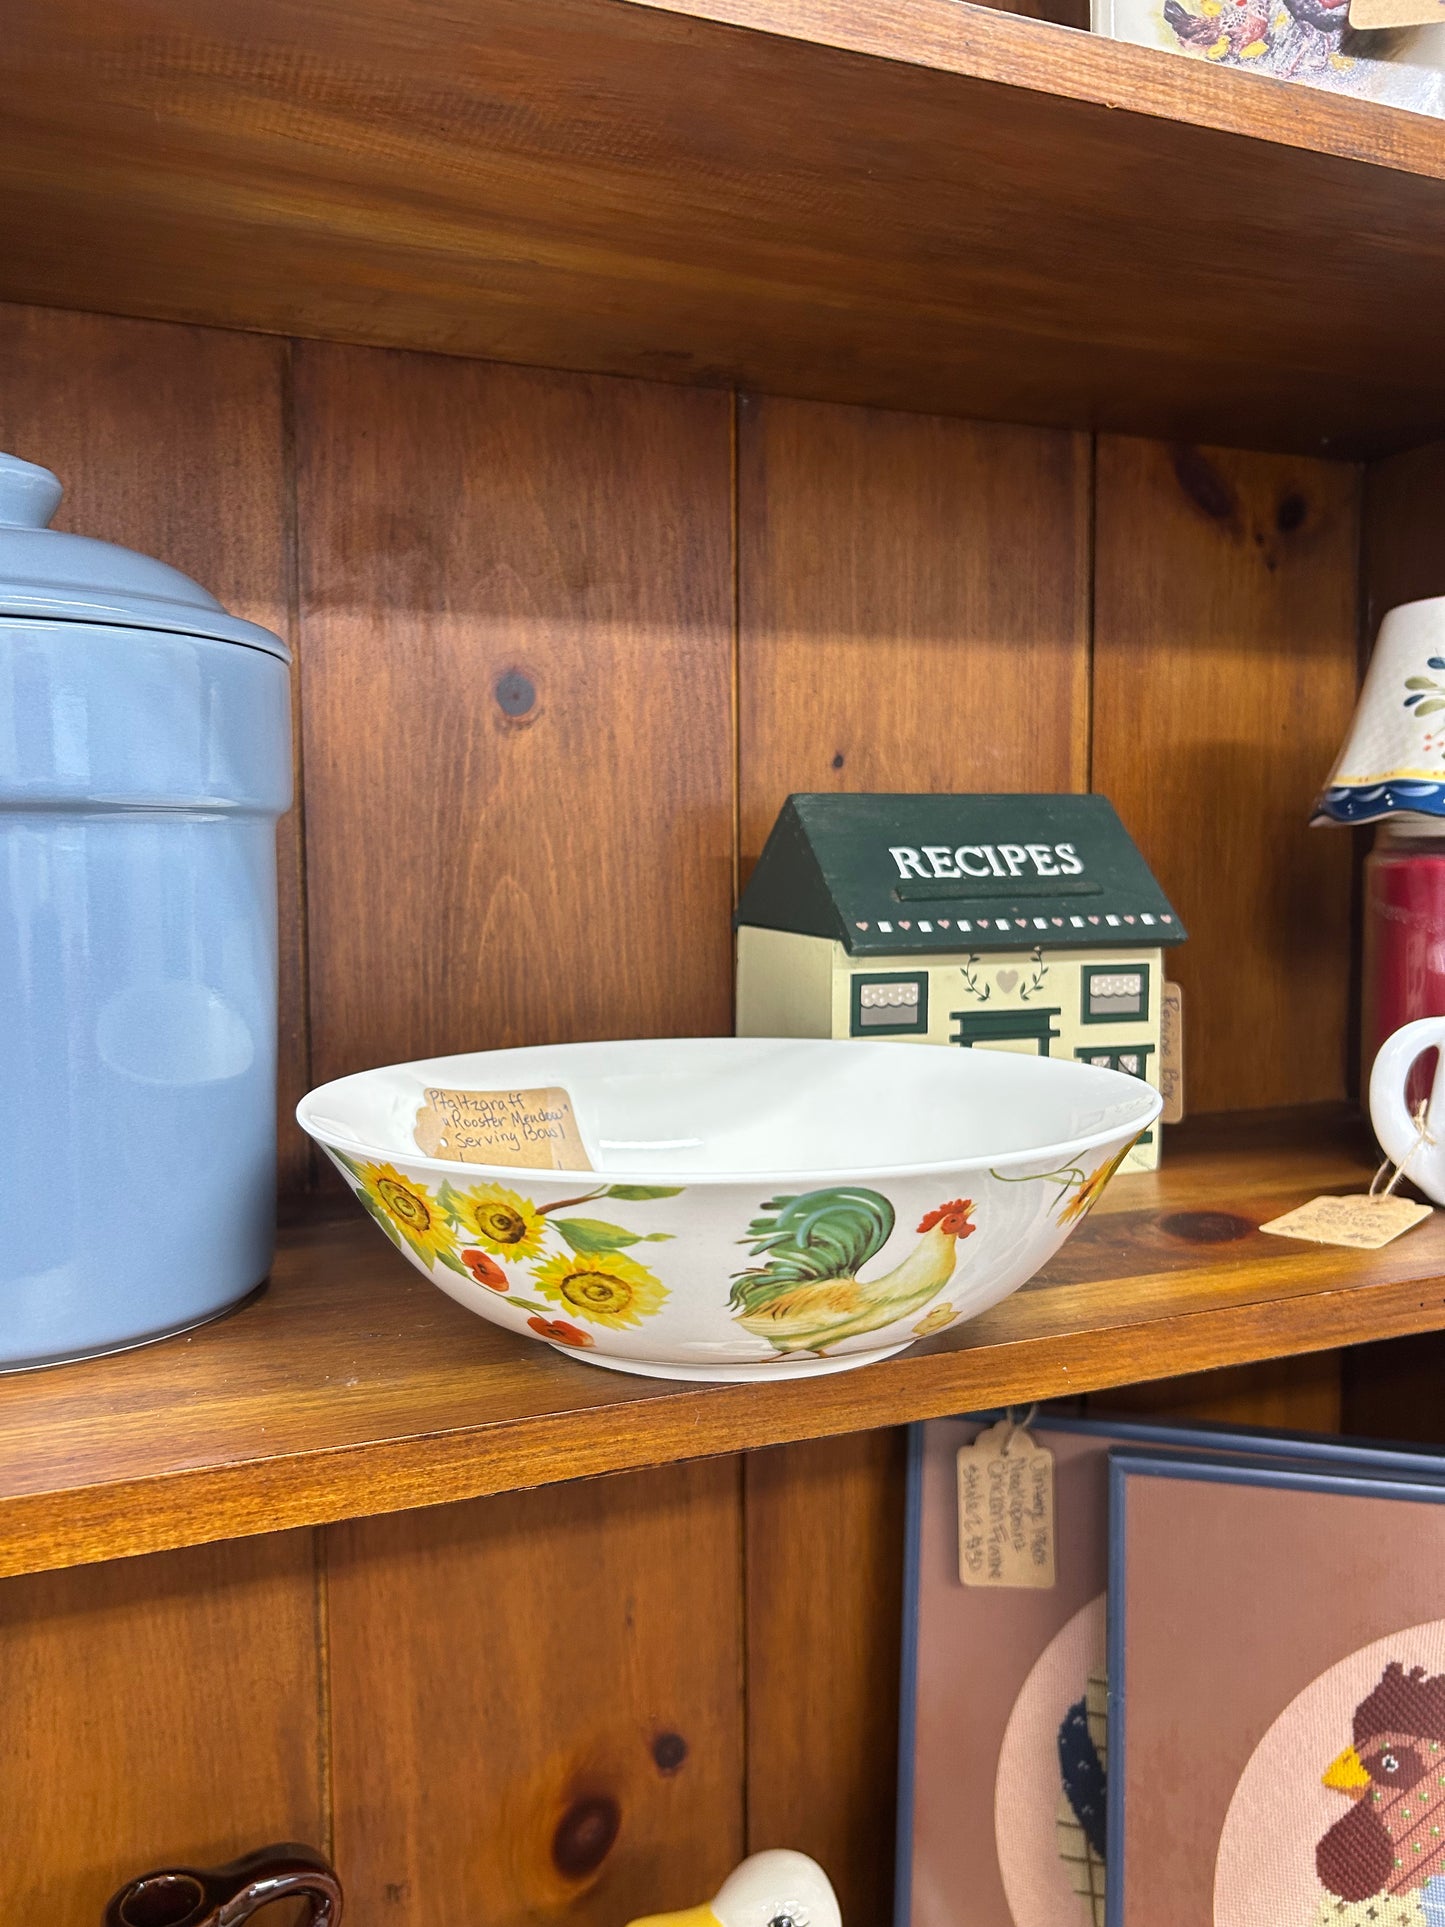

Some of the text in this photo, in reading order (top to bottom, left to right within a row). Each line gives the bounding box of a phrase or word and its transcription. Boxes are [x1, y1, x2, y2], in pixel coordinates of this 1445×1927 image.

[888, 843, 1085, 879] RECIPES
[429, 1089, 524, 1113] Pfaltzgraff
[455, 1123, 566, 1151] Serving Bowl
